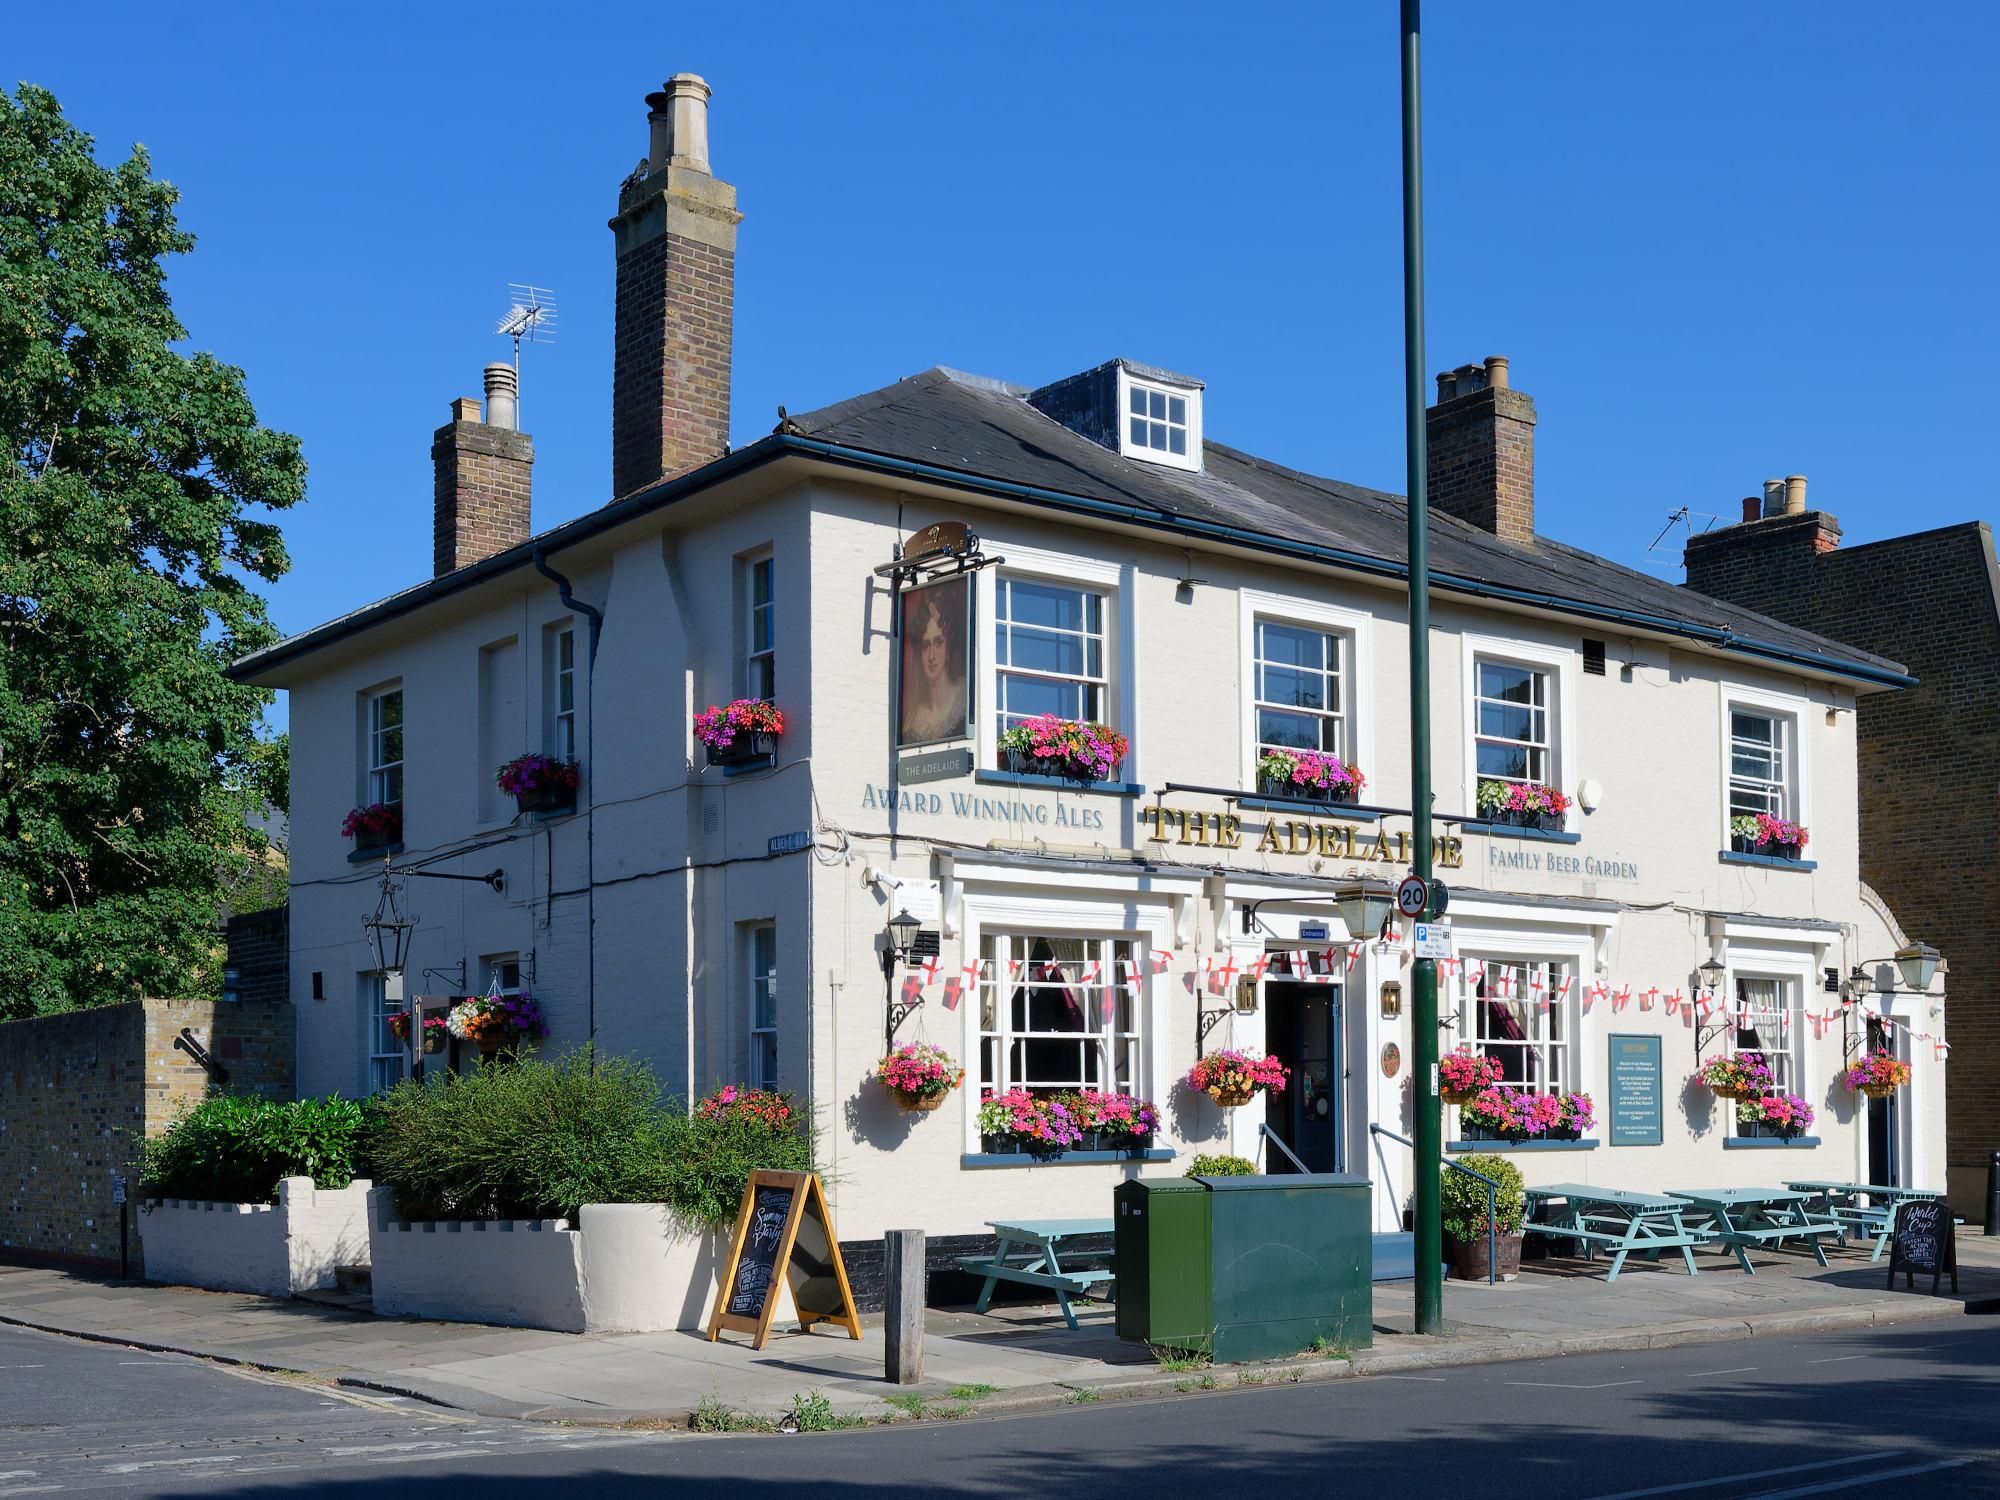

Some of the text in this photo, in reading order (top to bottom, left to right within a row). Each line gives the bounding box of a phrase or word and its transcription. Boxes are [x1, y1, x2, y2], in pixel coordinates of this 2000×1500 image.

[905, 758, 960, 777] THE ADELAIDE
[862, 783, 1104, 830] AWARD WINNING ALES
[1144, 805, 1242, 849] THE
[1489, 846, 1638, 879] FAMILY BEER GARDEN
[1402, 888, 1423, 906] 20
[754, 1207, 786, 1231] Summer
[1904, 1205, 1939, 1220] World
[1908, 1218, 1936, 1233] Cup
